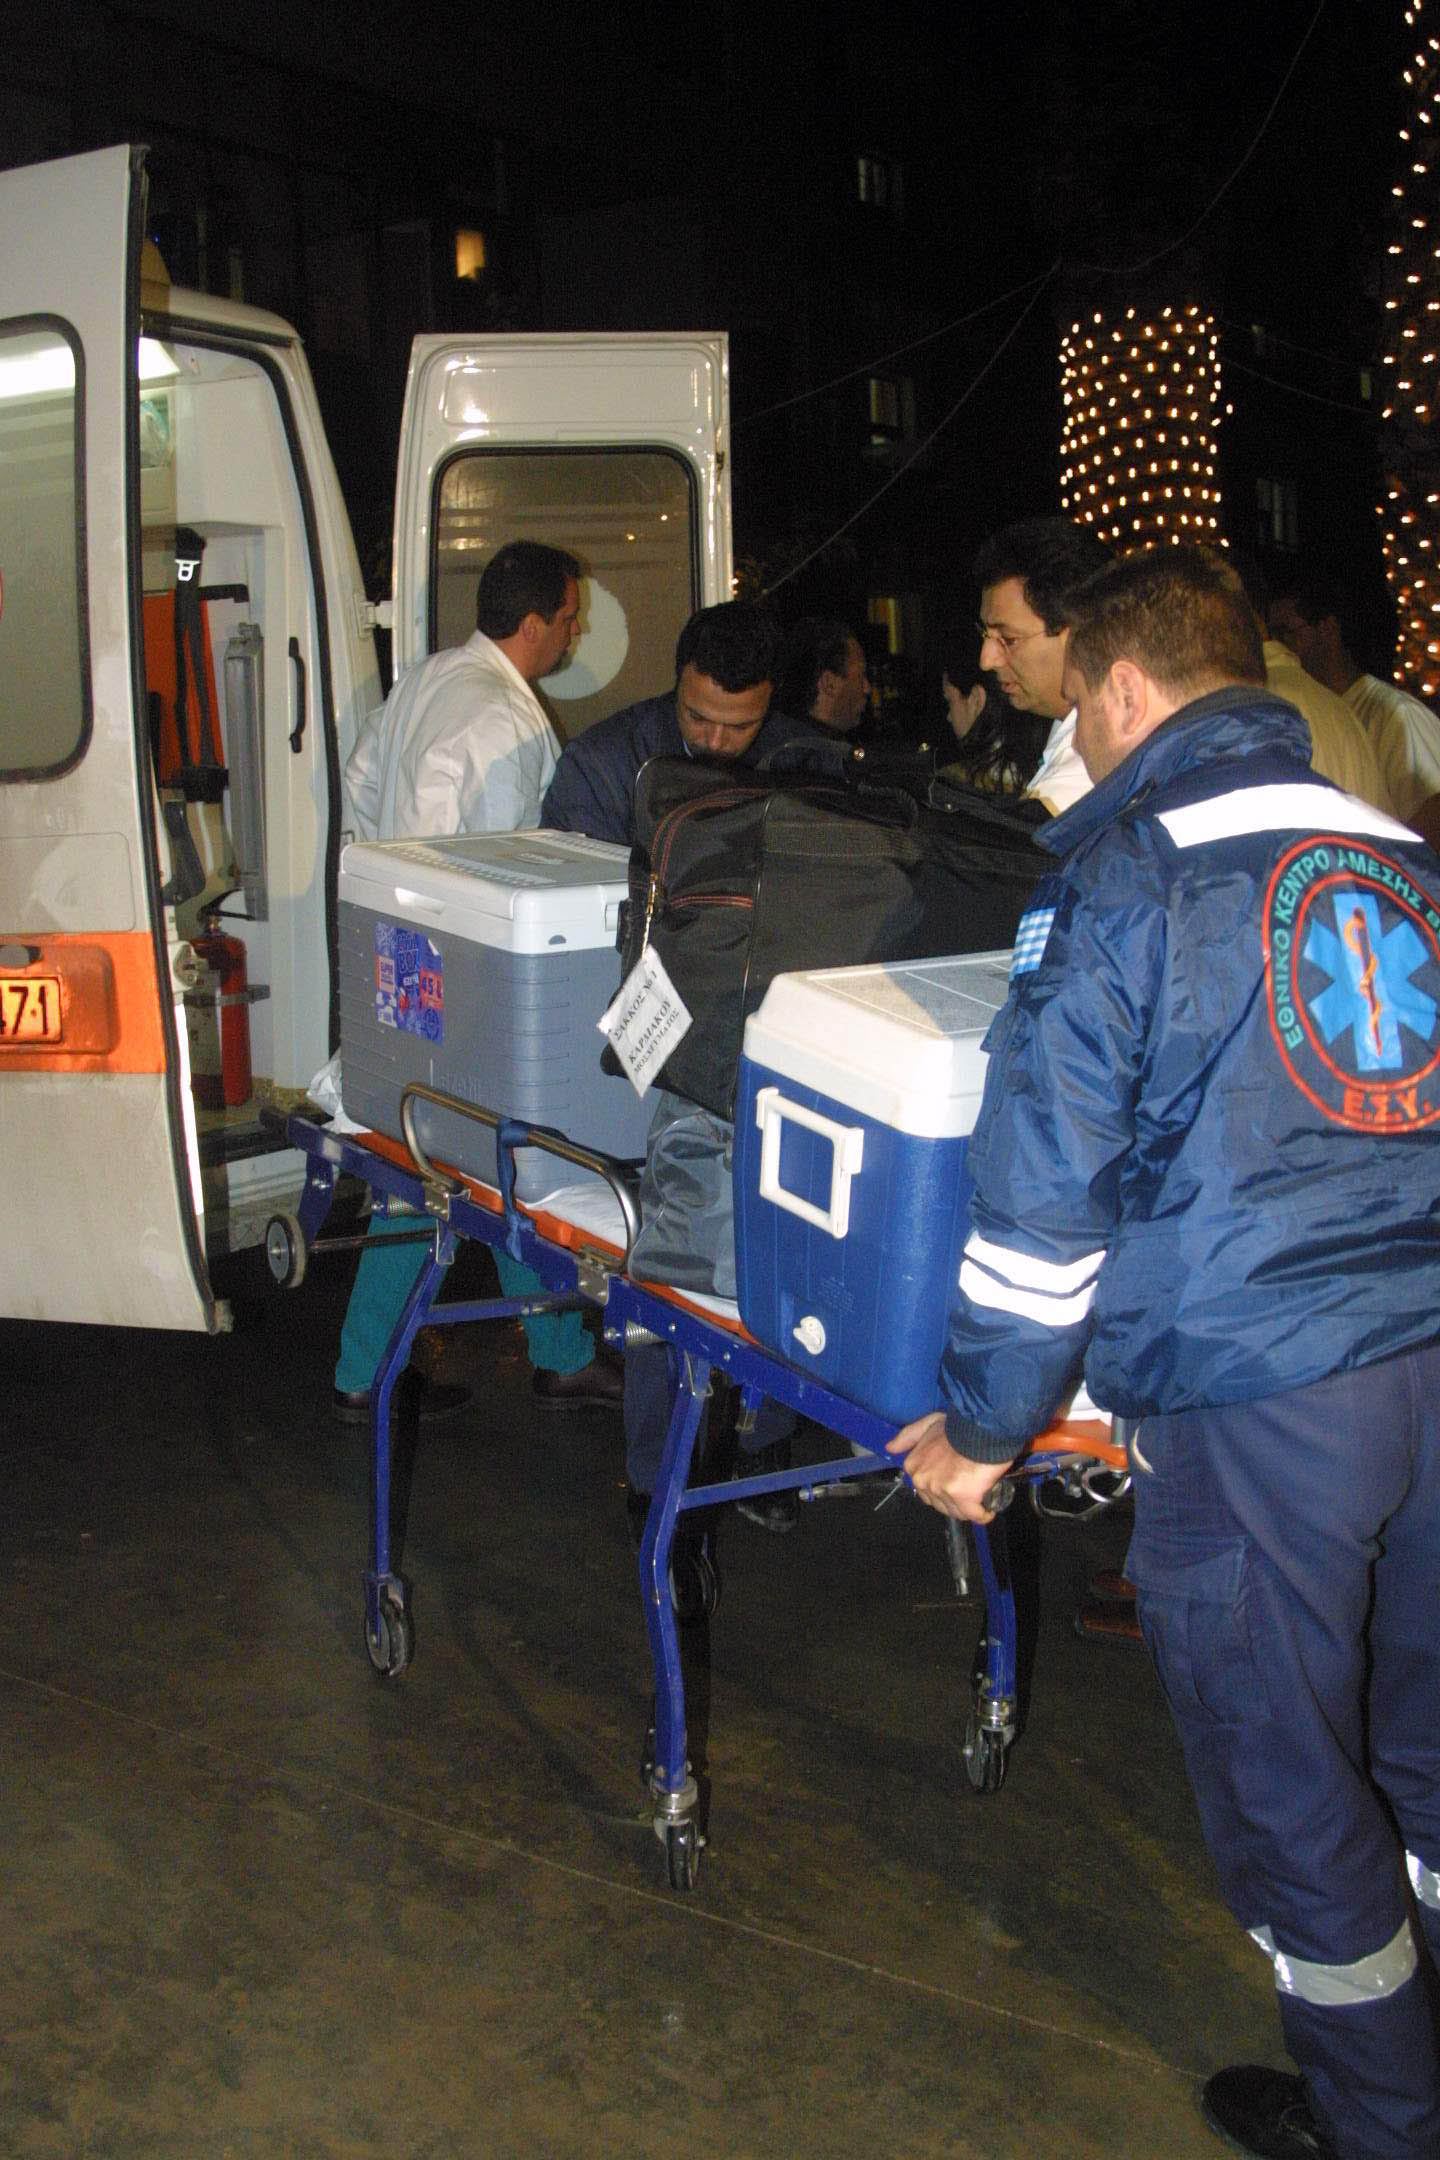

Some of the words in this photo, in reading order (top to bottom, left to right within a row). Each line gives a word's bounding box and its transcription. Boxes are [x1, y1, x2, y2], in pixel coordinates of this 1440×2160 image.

[1274, 848, 1331, 923] ΚΕΝΤΡΟ
[1337, 849, 1423, 909] ΑΜΕΣΗΣ
[1273, 927, 1304, 1051] ΕΘΝΙΚΟ
